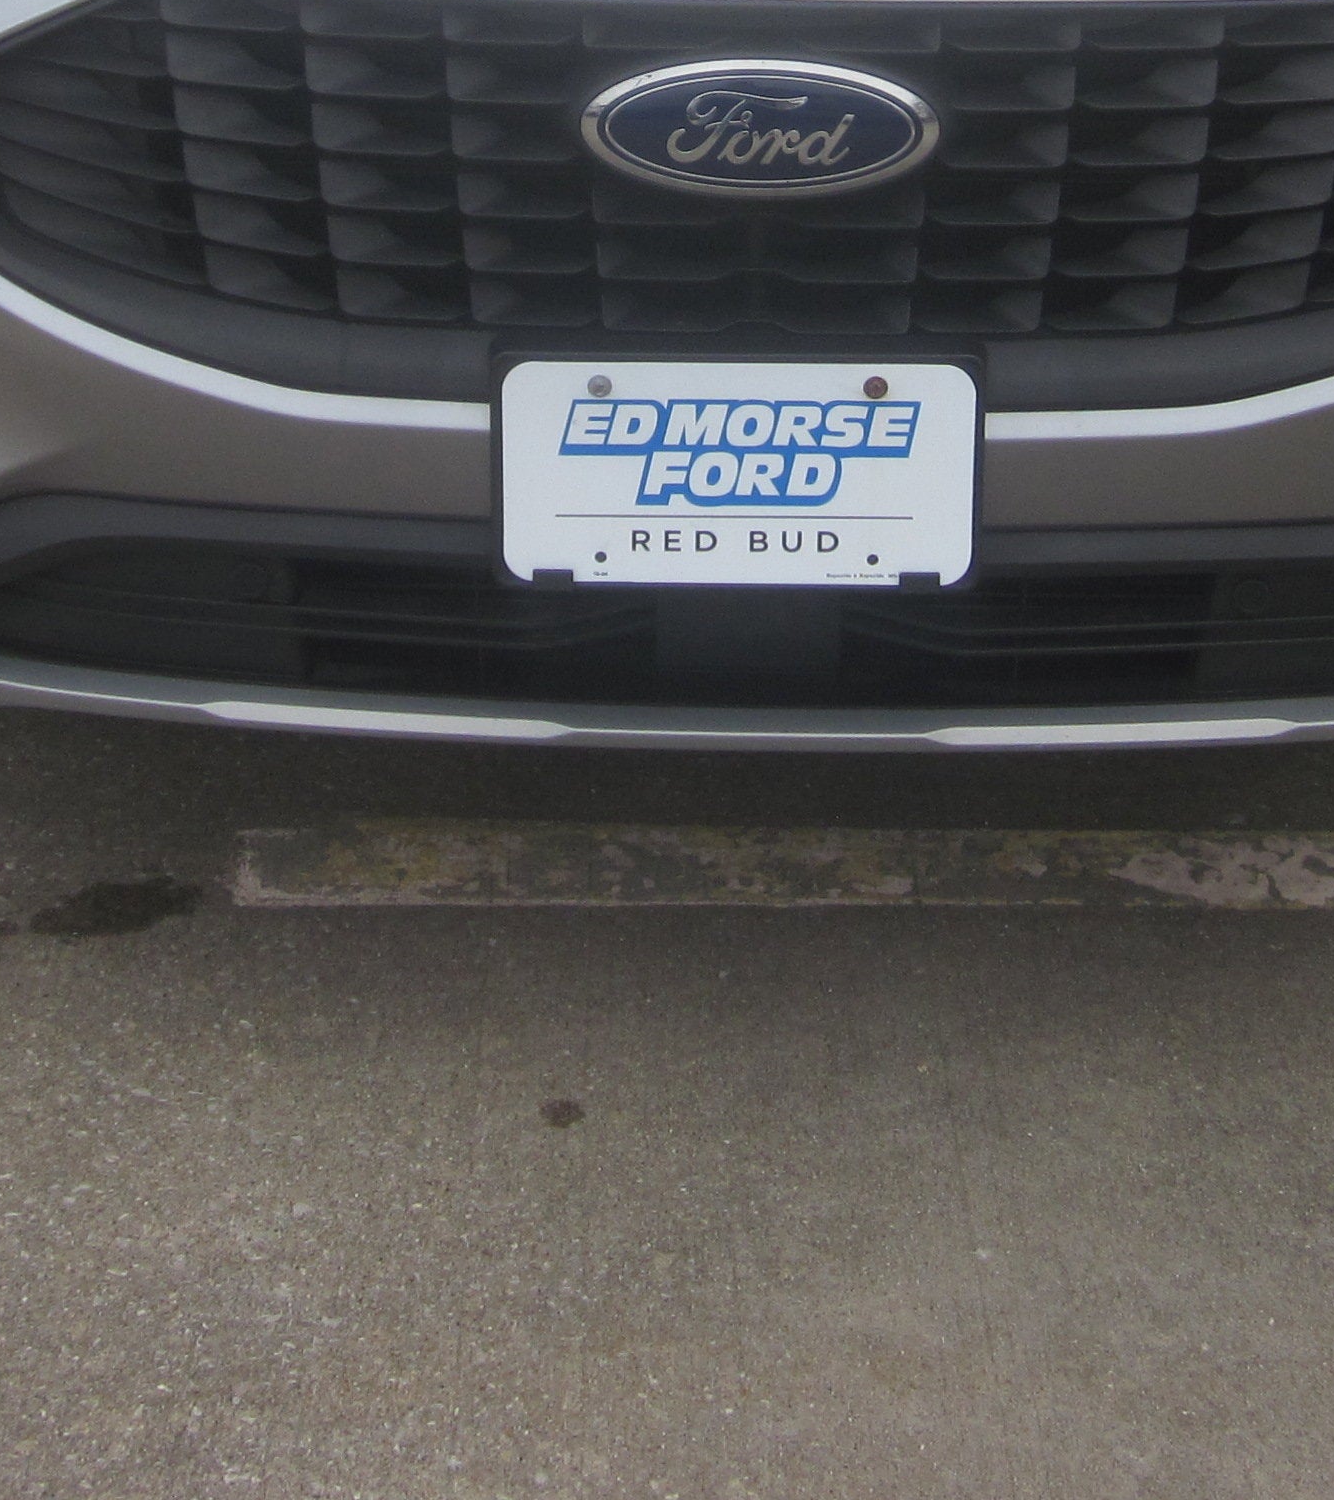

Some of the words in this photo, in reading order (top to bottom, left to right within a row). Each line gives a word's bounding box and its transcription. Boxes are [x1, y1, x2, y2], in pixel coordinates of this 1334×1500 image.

[666, 90, 855, 165] Ford
[565, 403, 658, 446] ED
[663, 404, 915, 448] MORSE
[643, 452, 837, 498] FORD
[631, 530, 718, 553] RED
[749, 531, 840, 554] BUD
